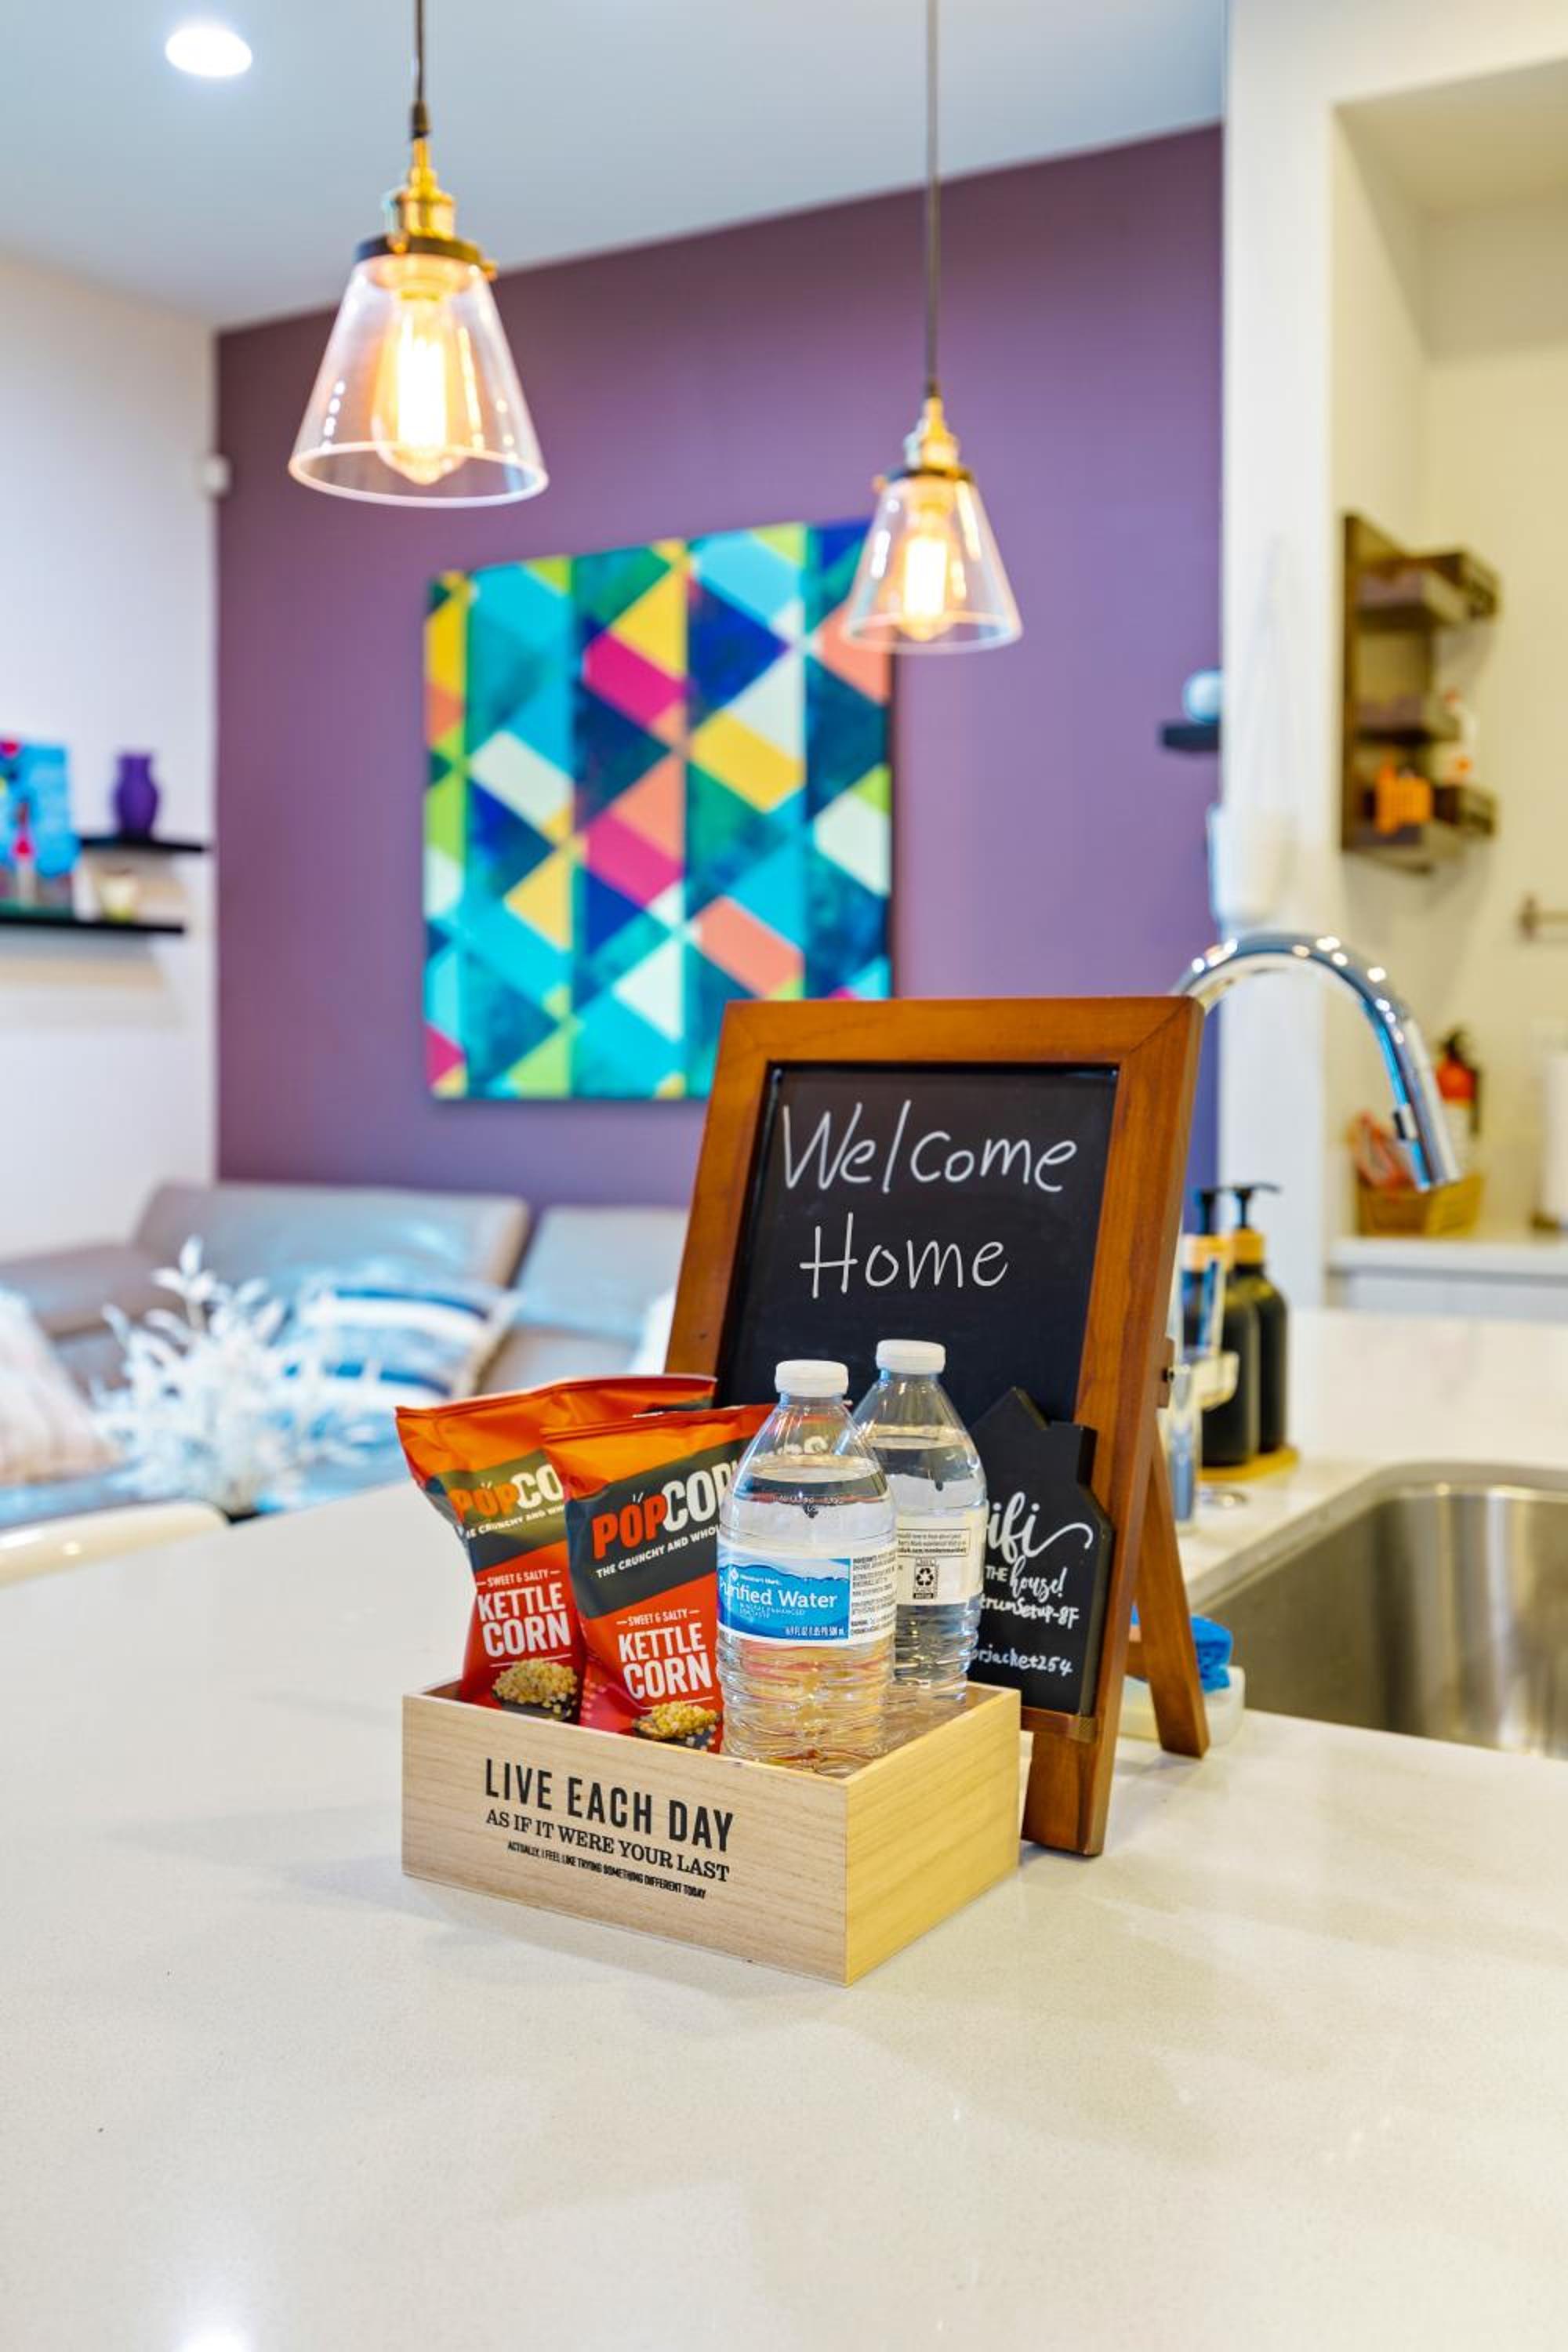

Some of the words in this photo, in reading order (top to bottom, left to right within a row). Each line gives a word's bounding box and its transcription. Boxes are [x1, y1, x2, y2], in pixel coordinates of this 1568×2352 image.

[783, 1100, 1077, 1194] Welcome
[799, 1212, 1008, 1299] Home
[526, 1509, 546, 1521] AND
[986, 1492, 1093, 1564] ifi
[487, 1573, 514, 1587] SWEET
[523, 1569, 549, 1582] SALTY
[596, 1563, 616, 1579] THE
[618, 1544, 666, 1570] CRUNCHY
[667, 1536, 688, 1552] AND
[985, 1566, 1009, 1582] THE
[477, 1582, 566, 1622] KETTLE
[628, 1613, 653, 1627] SWEET
[662, 1608, 688, 1621] SALTY
[778, 1589, 838, 1608] Water
[482, 1611, 572, 1658] CORN
[618, 1622, 706, 1663] KETTLE
[623, 1652, 713, 1700] CORN
[486, 1758, 552, 1810] LIVE
[568, 1777, 652, 1835] EACH
[669, 1799, 733, 1852] DAY
[486, 1809, 510, 1828] AS
[514, 1814, 532, 1832] IF
[535, 1820, 554, 1838] IT
[557, 1825, 614, 1854] WERE
[618, 1840, 673, 1869] YOUR
[677, 1853, 730, 1882] LAST
[545, 1850, 560, 1863] FEEL
[561, 1853, 576, 1866] LIKE
[578, 1857, 602, 1873] TRYING
[603, 1864, 644, 1884] SOMETHING
[644, 1875, 681, 1893] DIFFERENT
[683, 1884, 706, 1899] TODAY
